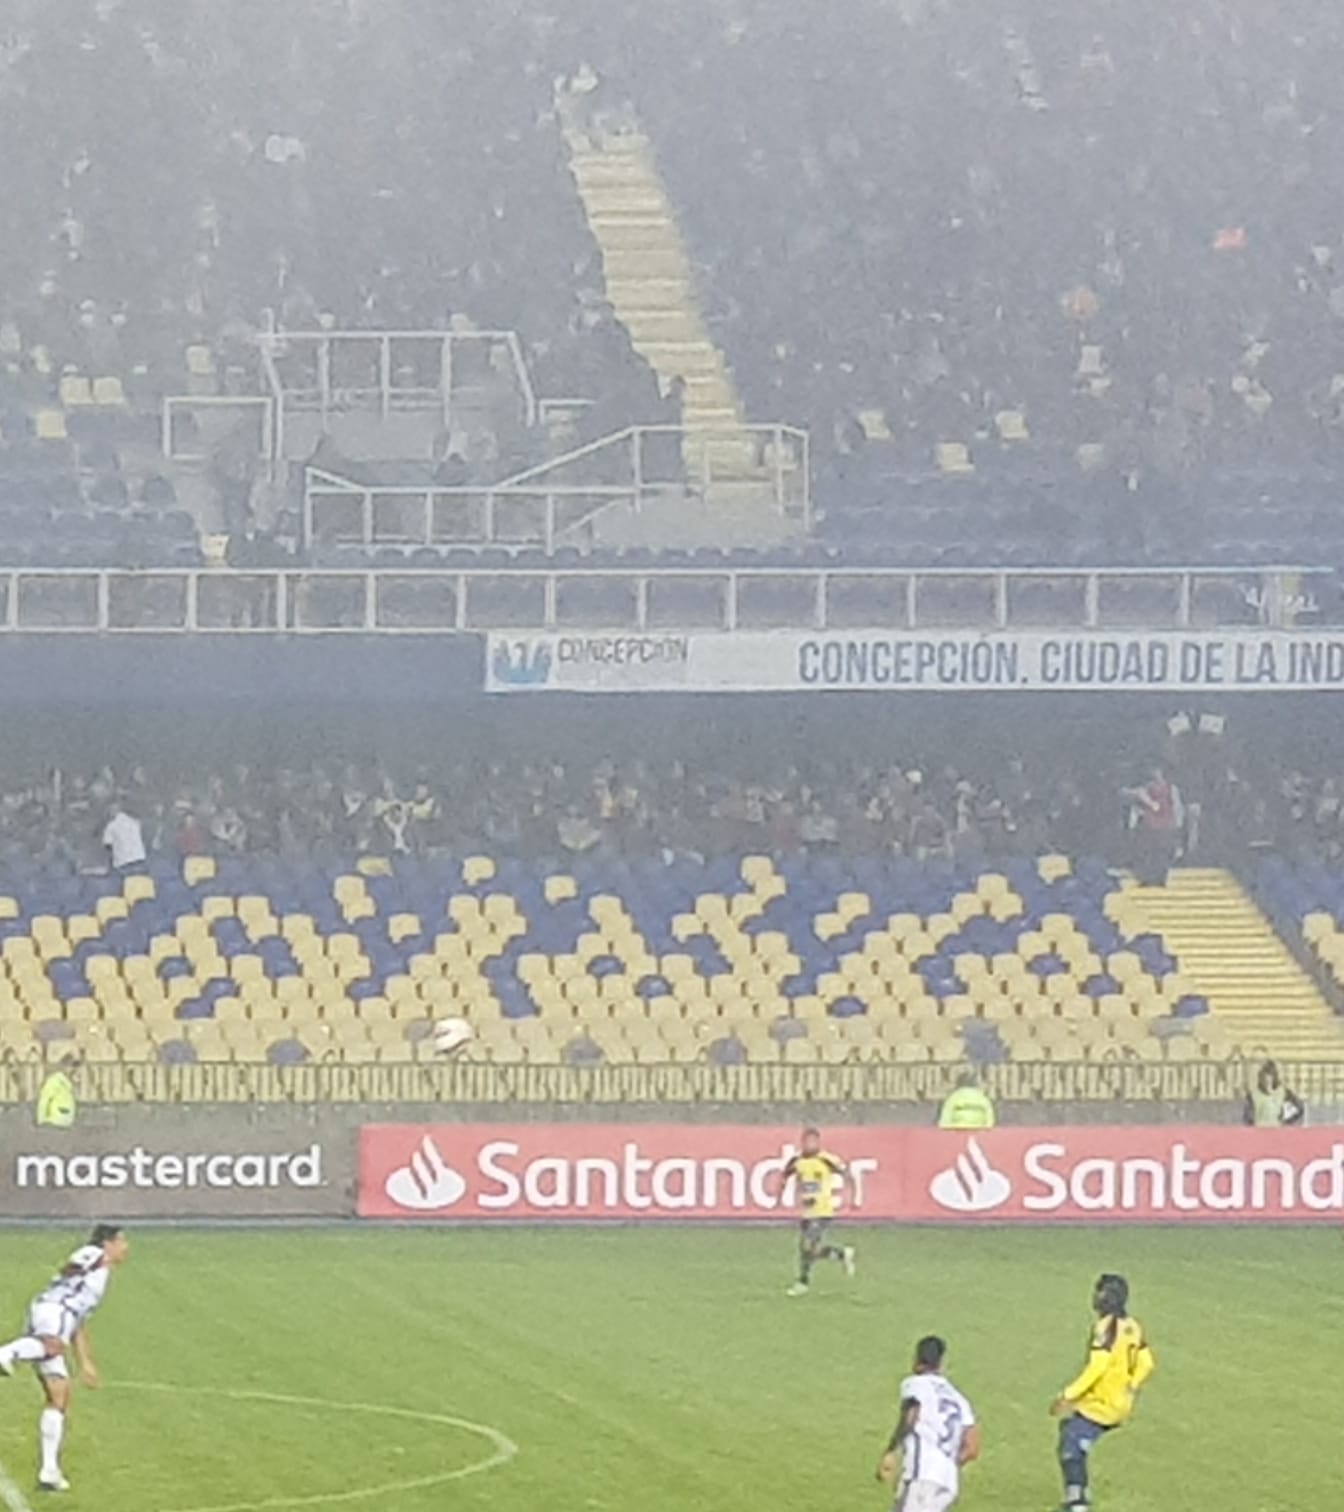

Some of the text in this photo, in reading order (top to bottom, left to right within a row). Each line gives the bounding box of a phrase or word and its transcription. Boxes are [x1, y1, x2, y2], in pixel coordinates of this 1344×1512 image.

[1040, 641, 1169, 684] CIUDAD
[1180, 641, 1224, 683] DE
[1235, 641, 1279, 683] LA
[17, 1144, 322, 1188] mastercard
[477, 1141, 878, 1209] Santandr
